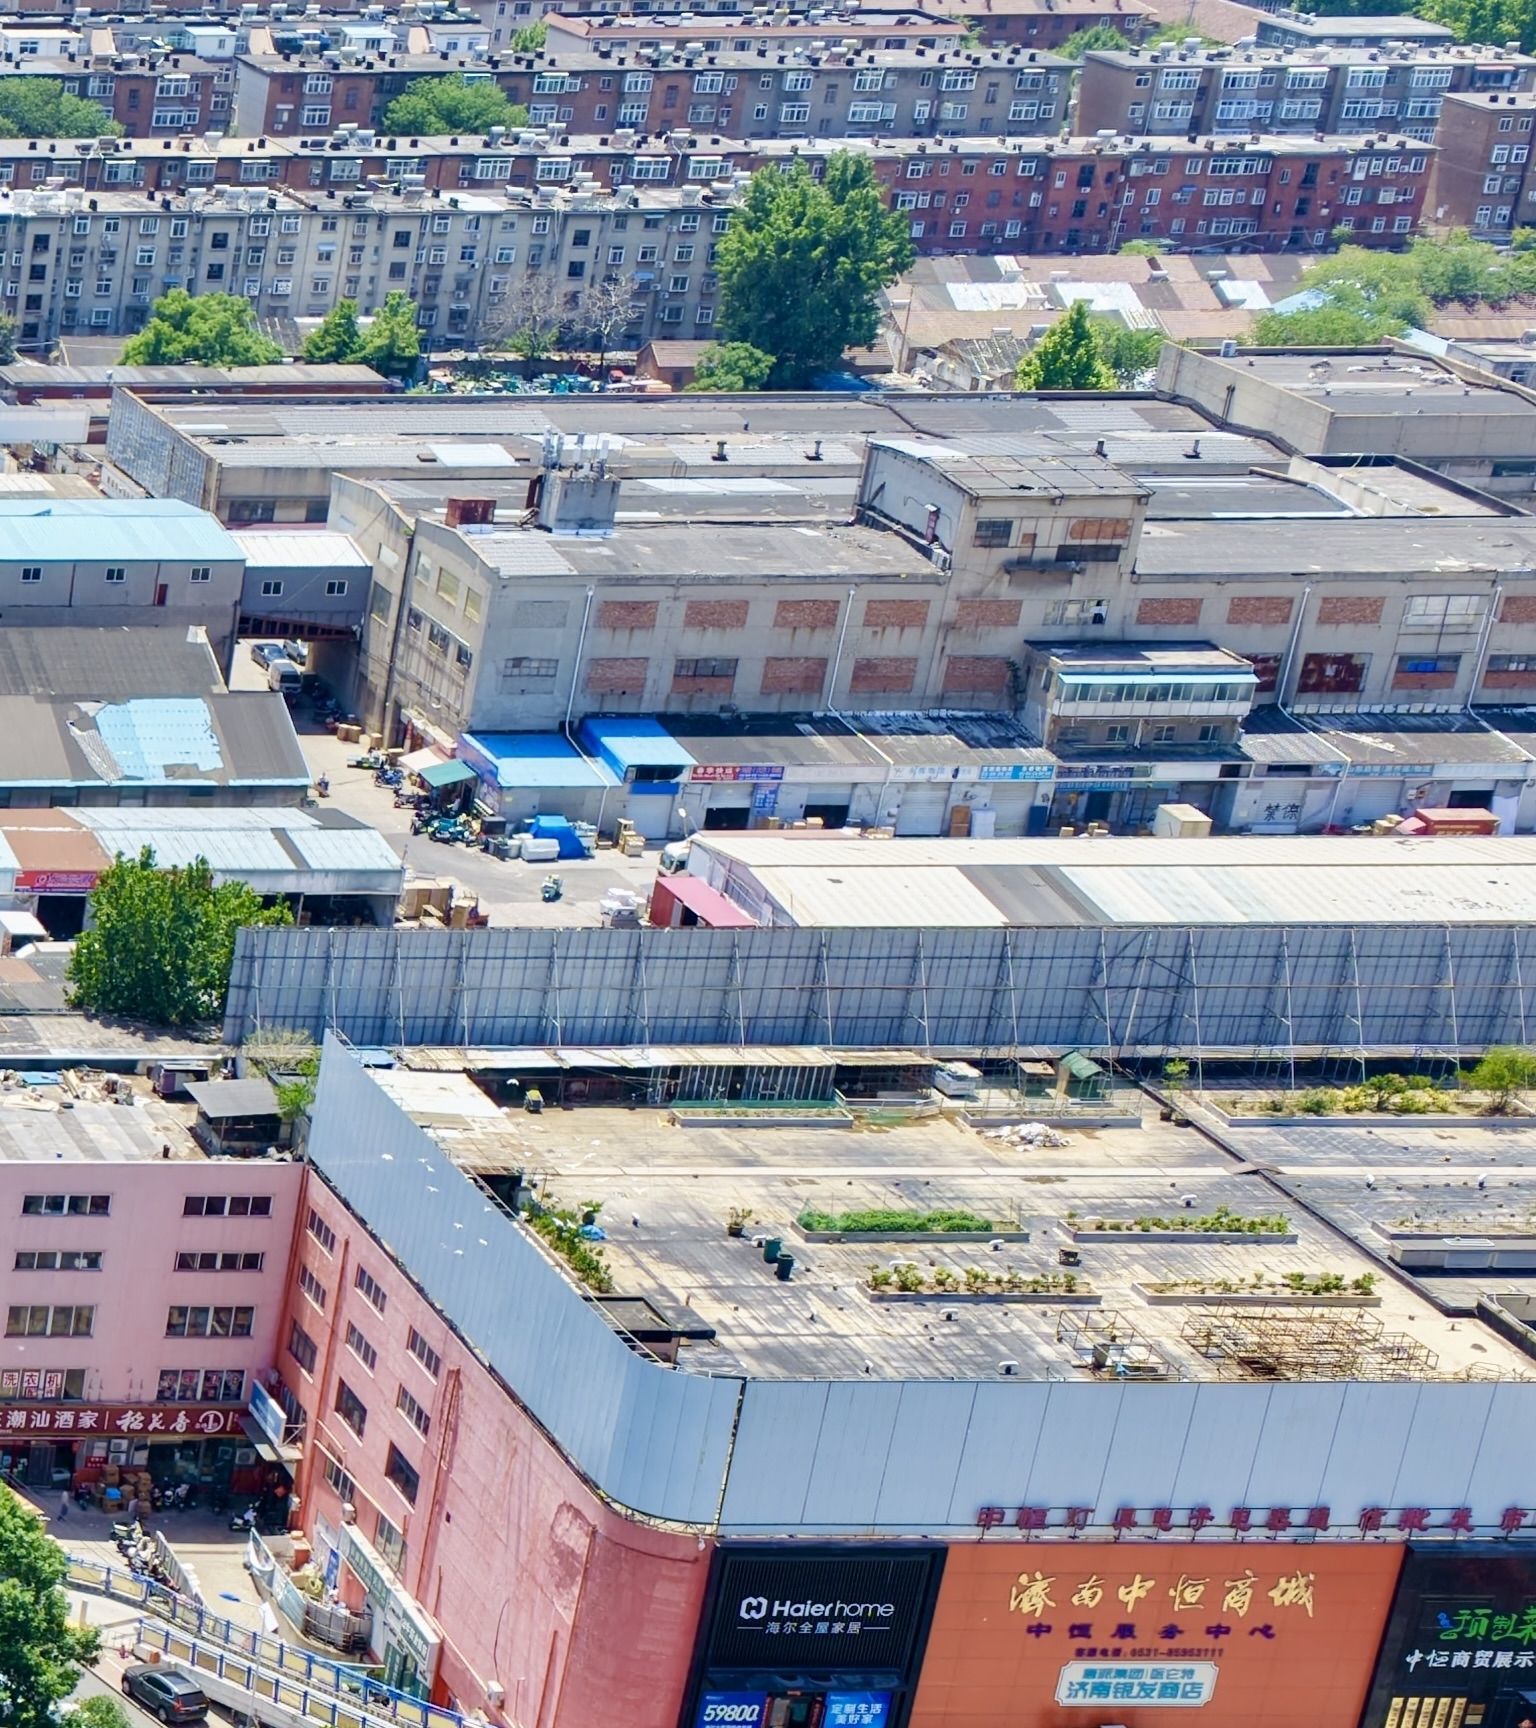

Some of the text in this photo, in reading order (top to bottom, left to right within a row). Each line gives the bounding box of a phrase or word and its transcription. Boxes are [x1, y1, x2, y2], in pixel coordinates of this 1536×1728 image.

[765, 1621, 862, 1635] 海尔全屋家居
[1026, 1622, 1276, 1640] 中恒服务中心
[1066, 1681, 1205, 1700] 济南银发商店
